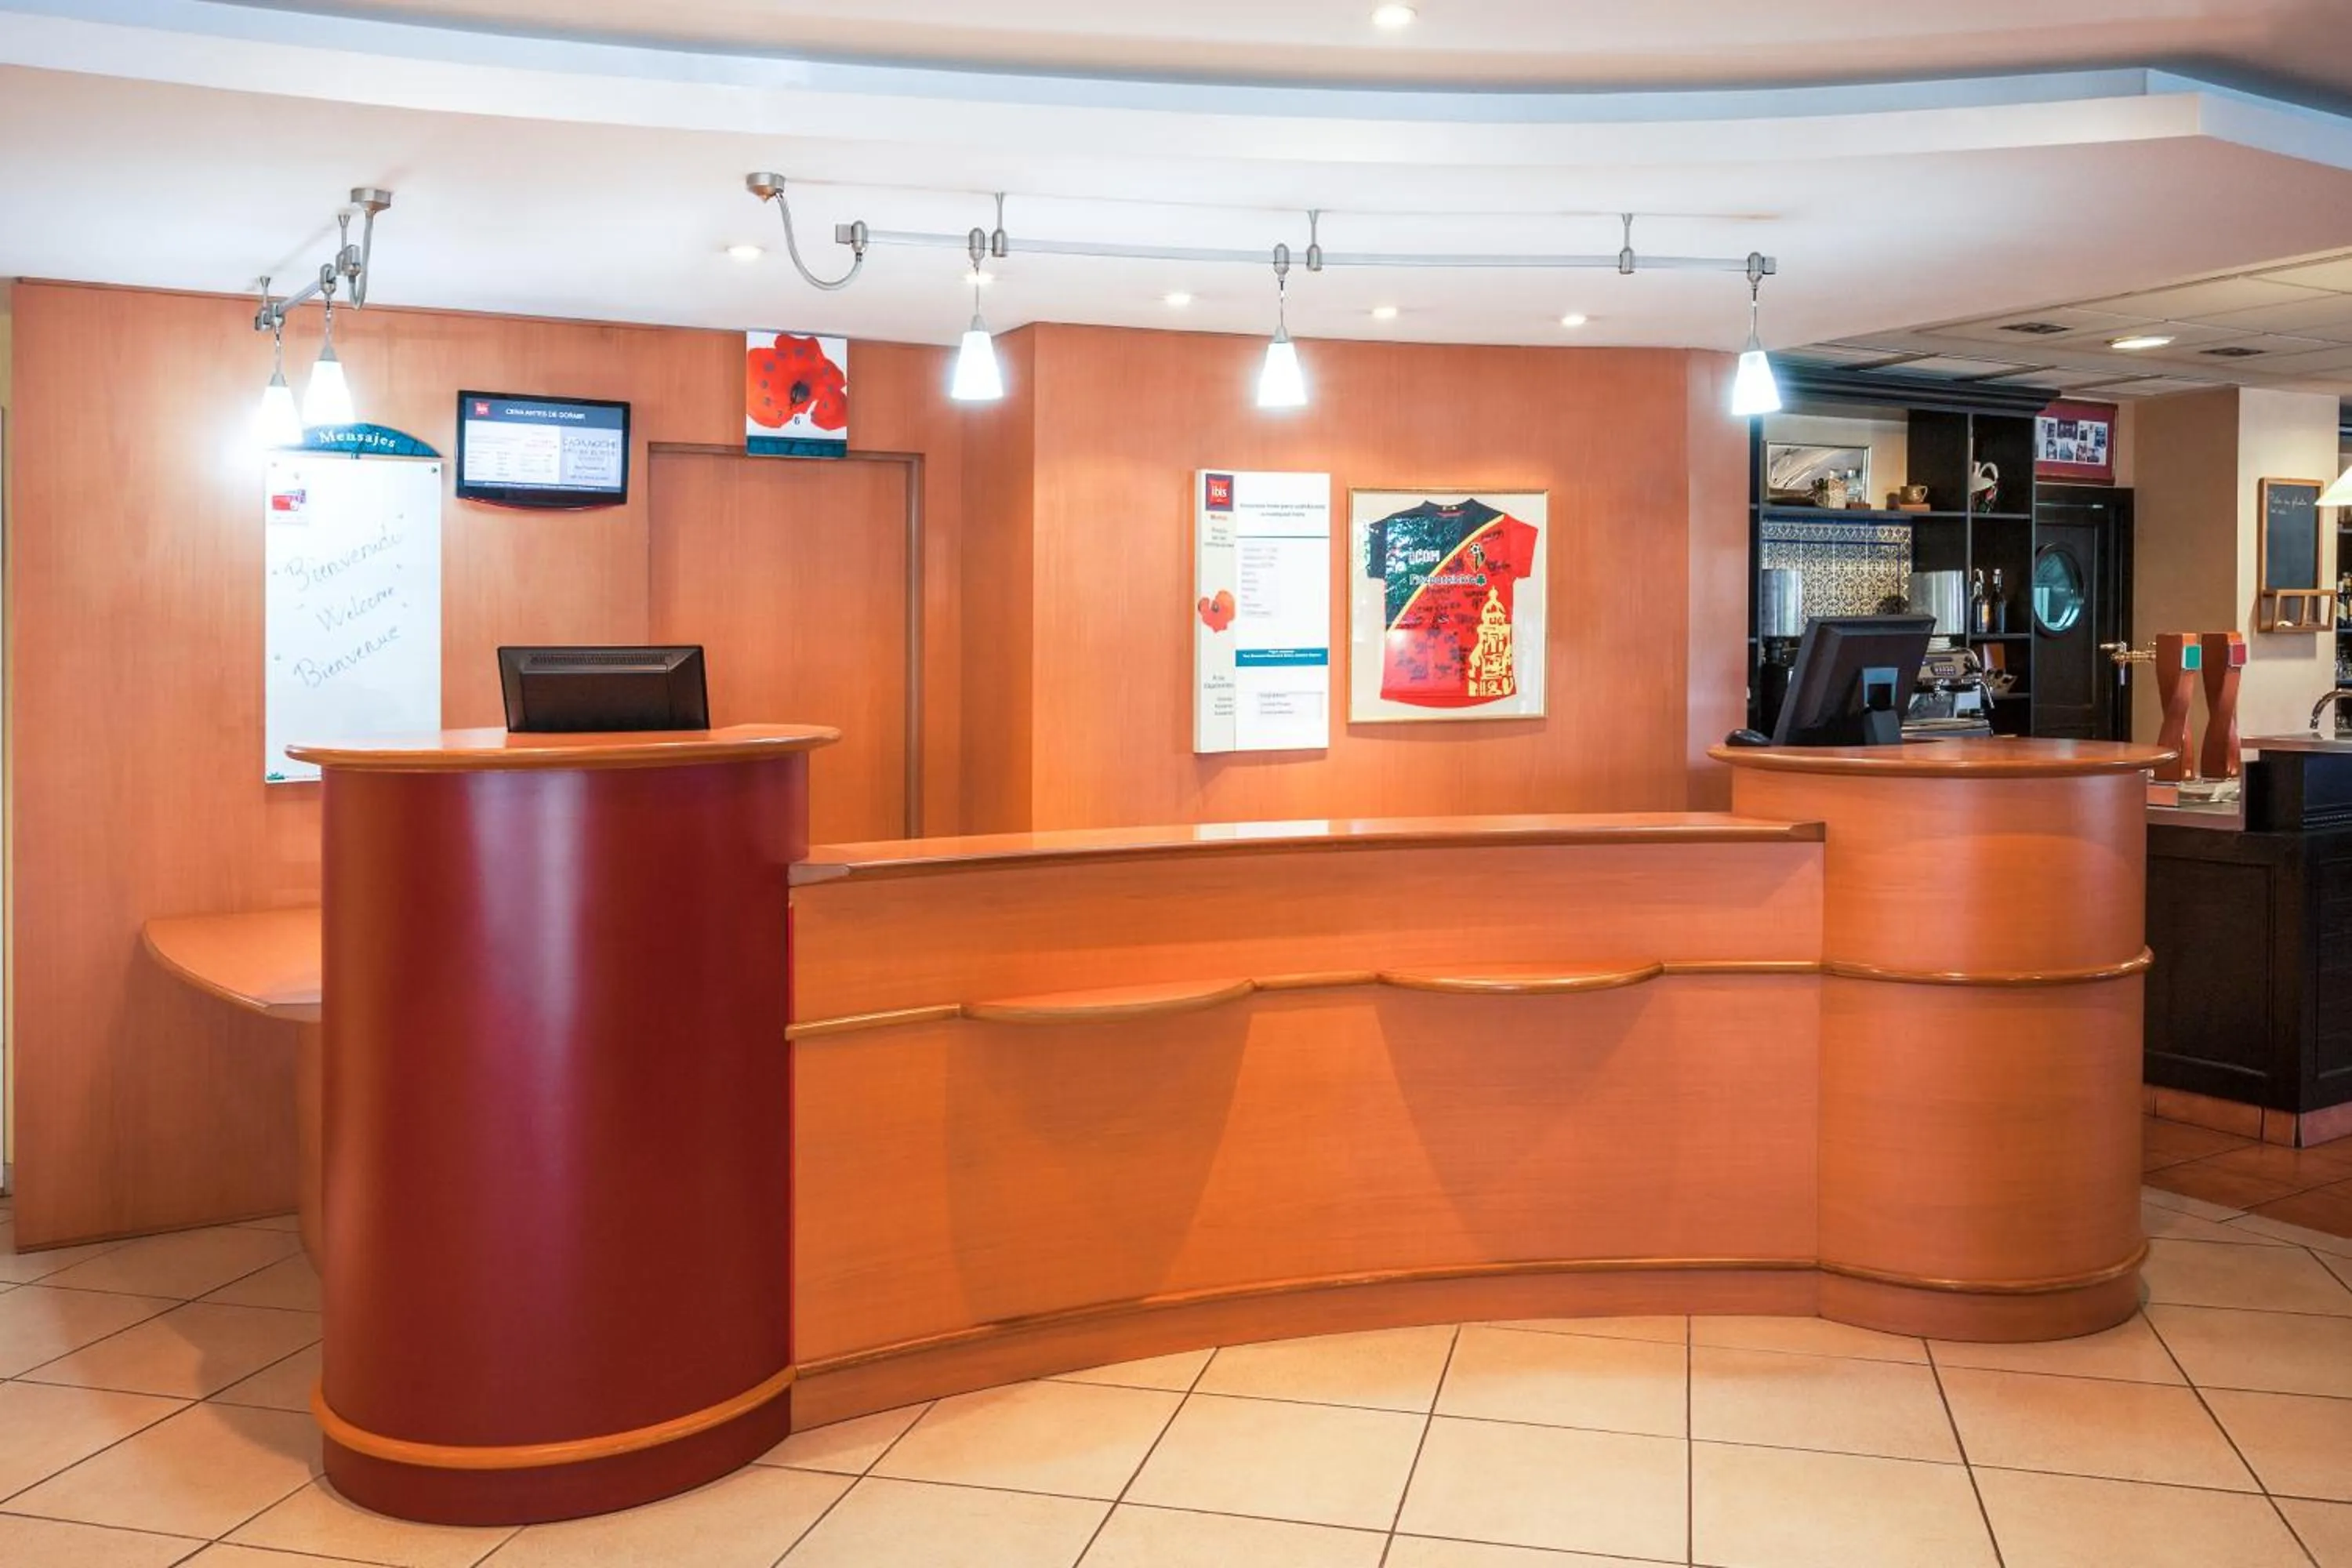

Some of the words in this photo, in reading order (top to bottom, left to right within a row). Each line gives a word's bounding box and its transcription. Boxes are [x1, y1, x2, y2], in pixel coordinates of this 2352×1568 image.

[318, 429, 396, 448] Mensajes
[1211, 485, 1227, 498] ibis
[316, 586, 395, 633] Welcome
[293, 625, 401, 688] Bienvenue
